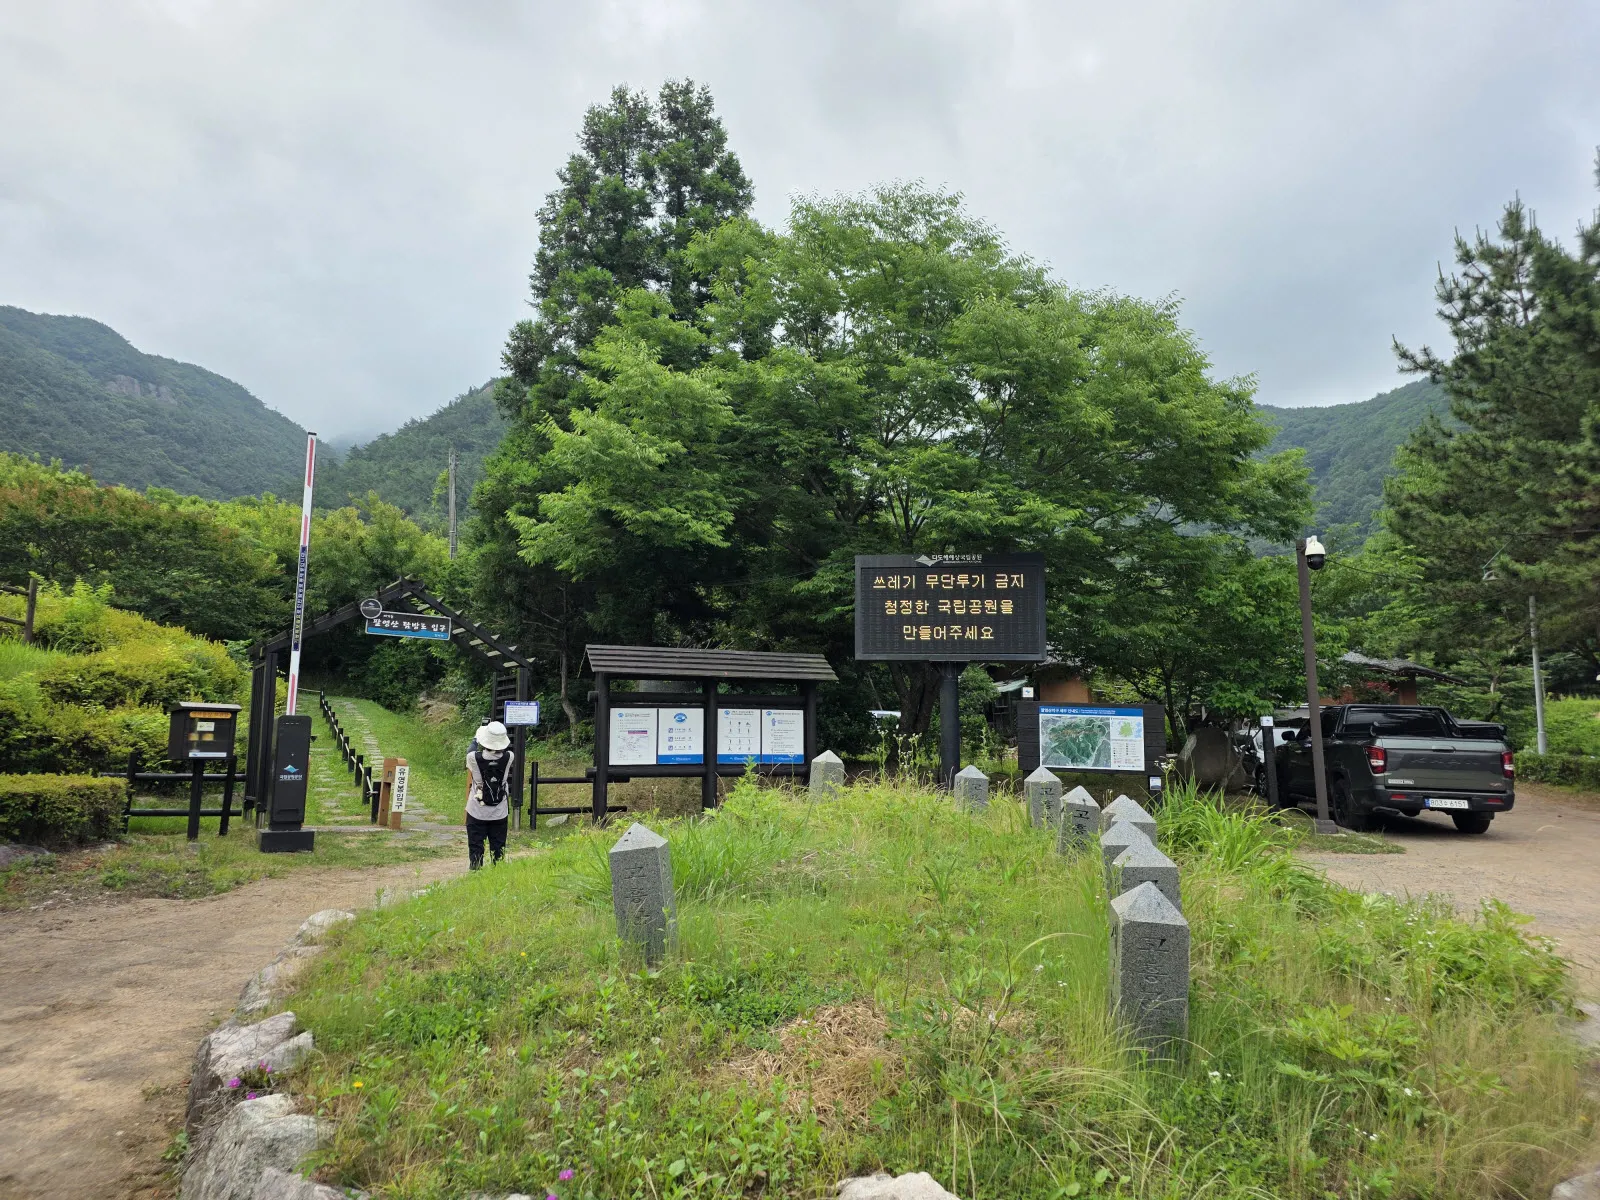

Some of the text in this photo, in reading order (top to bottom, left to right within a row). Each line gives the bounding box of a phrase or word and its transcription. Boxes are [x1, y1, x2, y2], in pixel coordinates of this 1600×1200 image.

[872, 573, 1025, 589] 쓰레기 무단투기 금지
[884, 599, 1014, 615] 청정한 국립공원을
[373, 618, 399, 628] 팔영산
[431, 623, 446, 632] 입구
[903, 625, 994, 641] 만들어주세요
[395, 767, 406, 810] 유영봉입구
